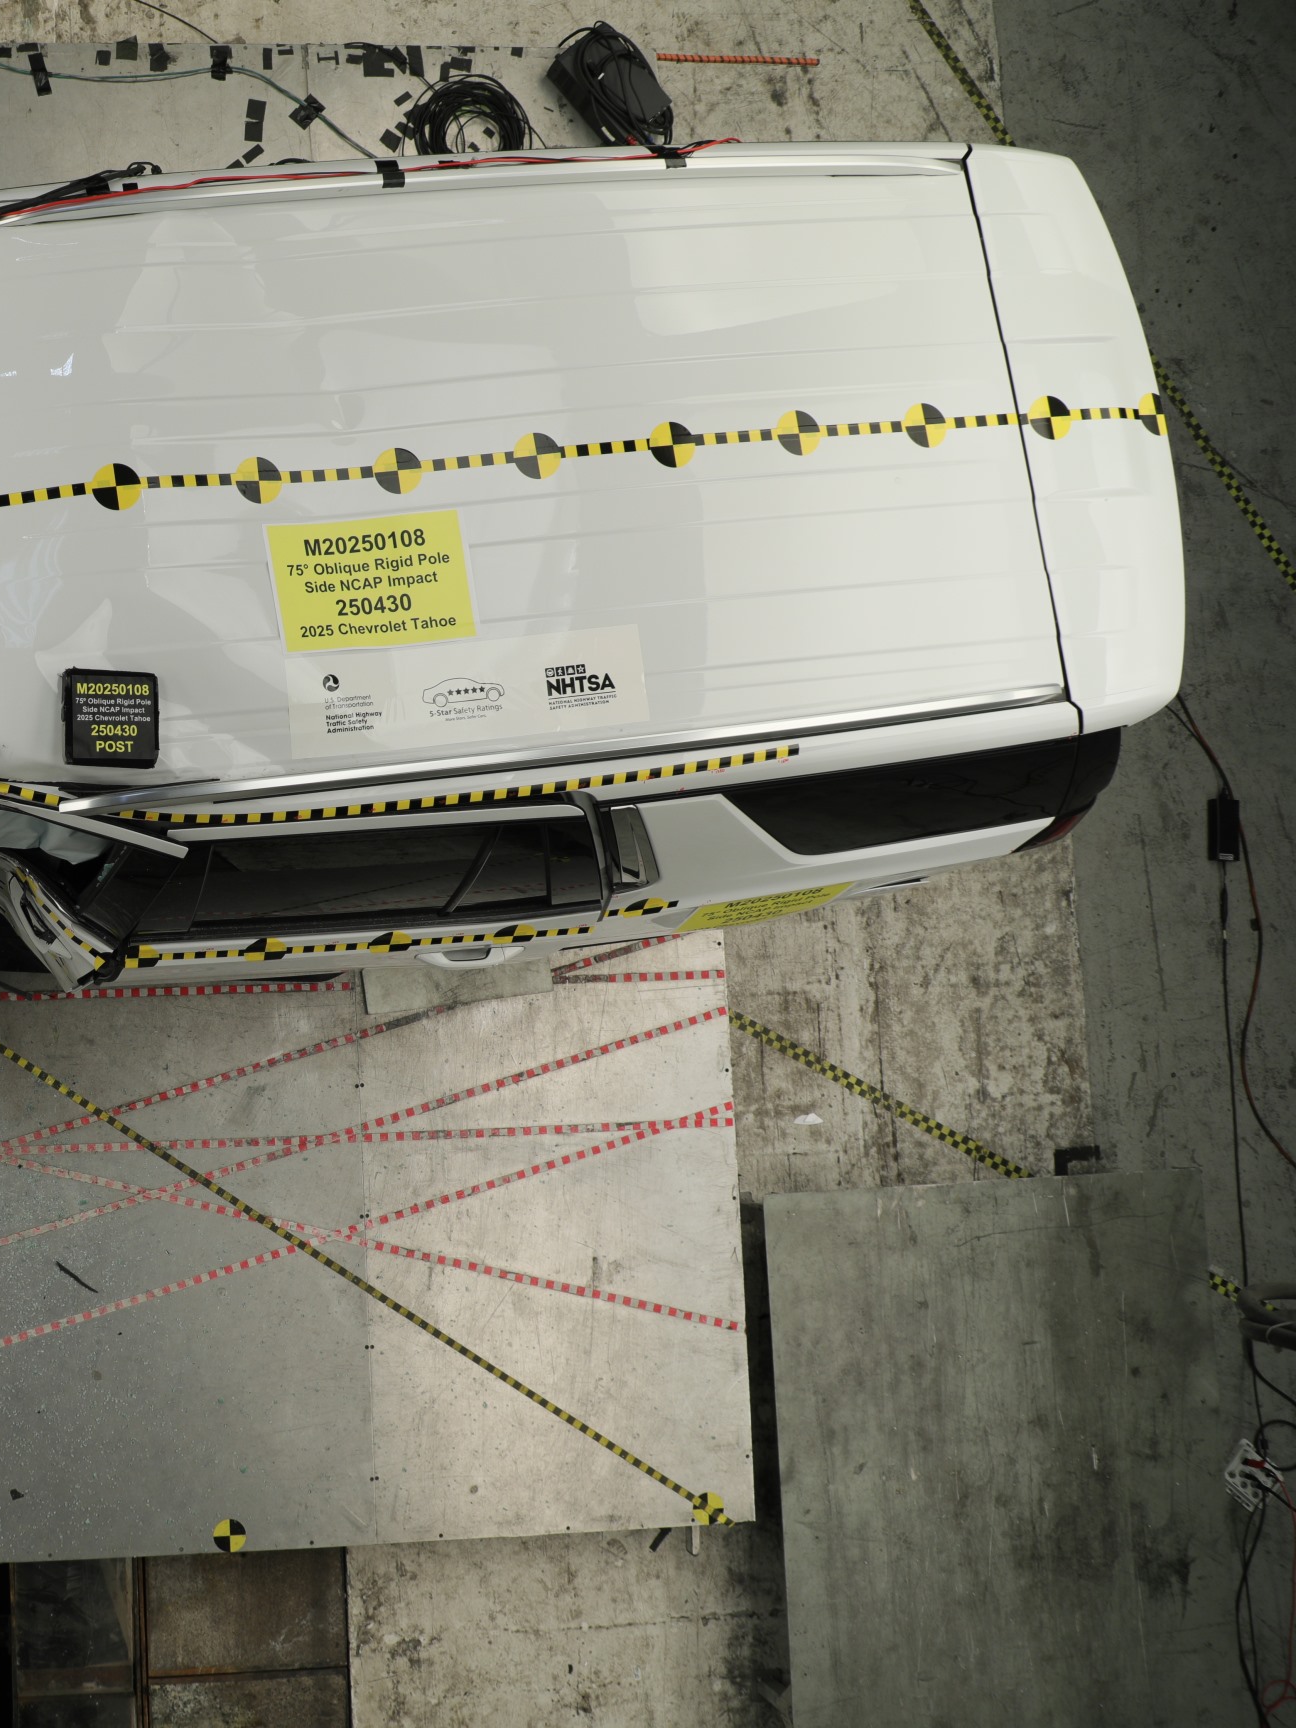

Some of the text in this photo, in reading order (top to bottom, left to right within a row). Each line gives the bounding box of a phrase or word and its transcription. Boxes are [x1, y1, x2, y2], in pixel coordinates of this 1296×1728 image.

[303, 528, 426, 557] M20250108
[287, 551, 450, 578] 75° Oblique Rigid Pole
[304, 570, 439, 594] Side NCAP Impact
[335, 592, 413, 617] 250430
[300, 614, 457, 638] 2025 Chevrolet Tahoe
[76, 683, 150, 696] M20250108
[546, 673, 616, 696] NHTSA
[88, 698, 115, 706] Oblique
[117, 698, 135, 706] Rigid
[332, 701, 374, 709] Transportation
[337, 694, 371, 703] Department
[429, 704, 503, 717] 5-Star Safety Ratings
[90, 724, 138, 737] 250430
[327, 724, 375, 734] Administration
[95, 740, 134, 753] POST
